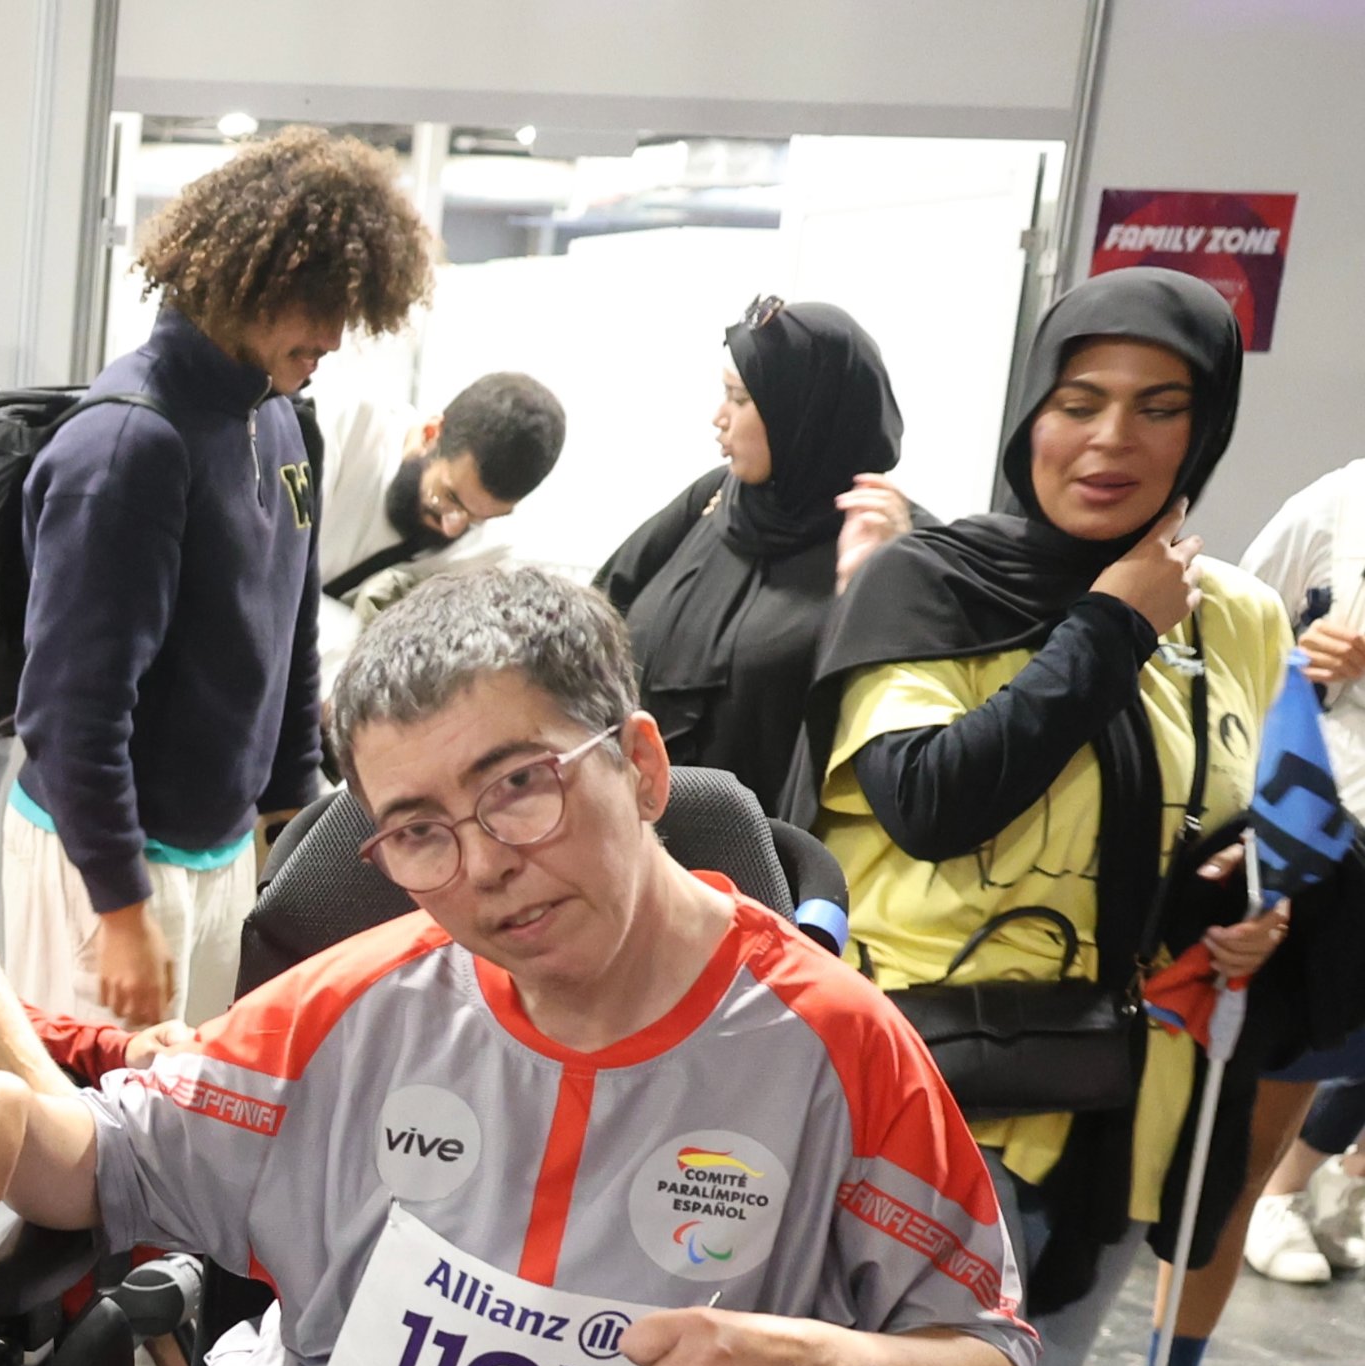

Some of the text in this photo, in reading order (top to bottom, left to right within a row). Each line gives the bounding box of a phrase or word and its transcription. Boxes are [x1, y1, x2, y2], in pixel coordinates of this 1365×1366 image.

[1104, 224, 1281, 255] FAMILY ZONE
[385, 1126, 465, 1162] vive
[684, 1167, 748, 1188] COMITÉ
[657, 1180, 769, 1207] PARALÍMPICO
[672, 1198, 747, 1221] ESPAÑOL
[423, 1257, 571, 1342] Allianz
